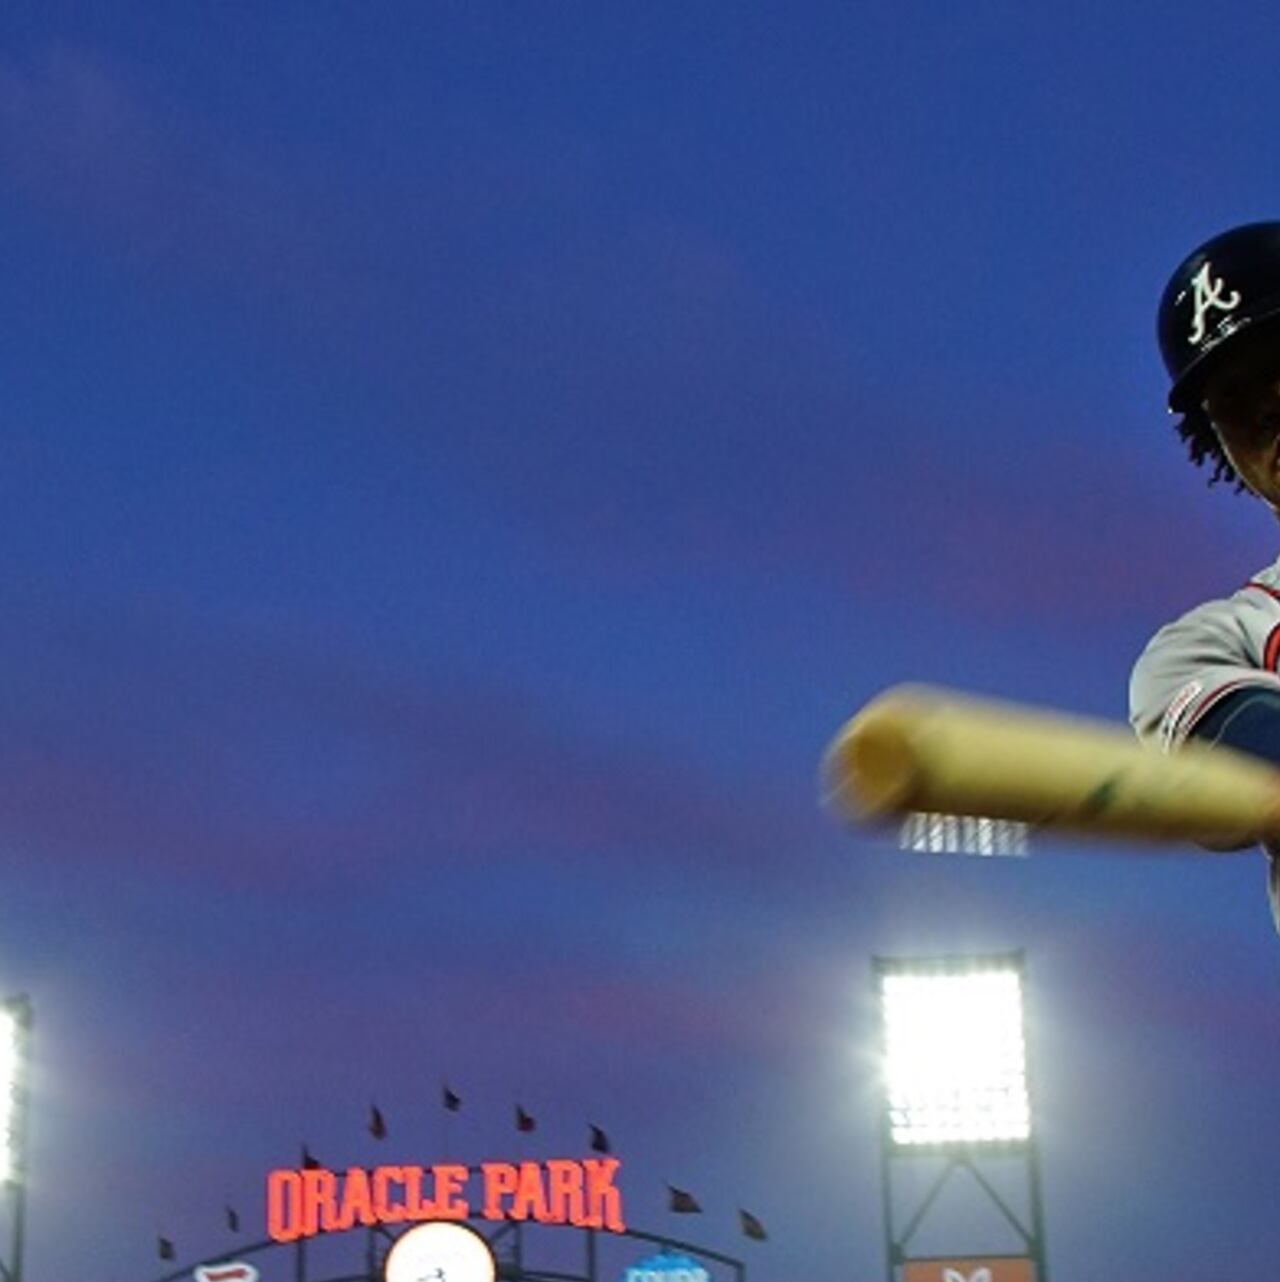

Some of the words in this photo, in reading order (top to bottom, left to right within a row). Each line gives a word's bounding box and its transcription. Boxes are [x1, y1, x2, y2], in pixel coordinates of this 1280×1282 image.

[1188, 261, 1240, 345] A
[268, 1164, 470, 1242] ORACLE
[481, 1159, 625, 1232] PARK
